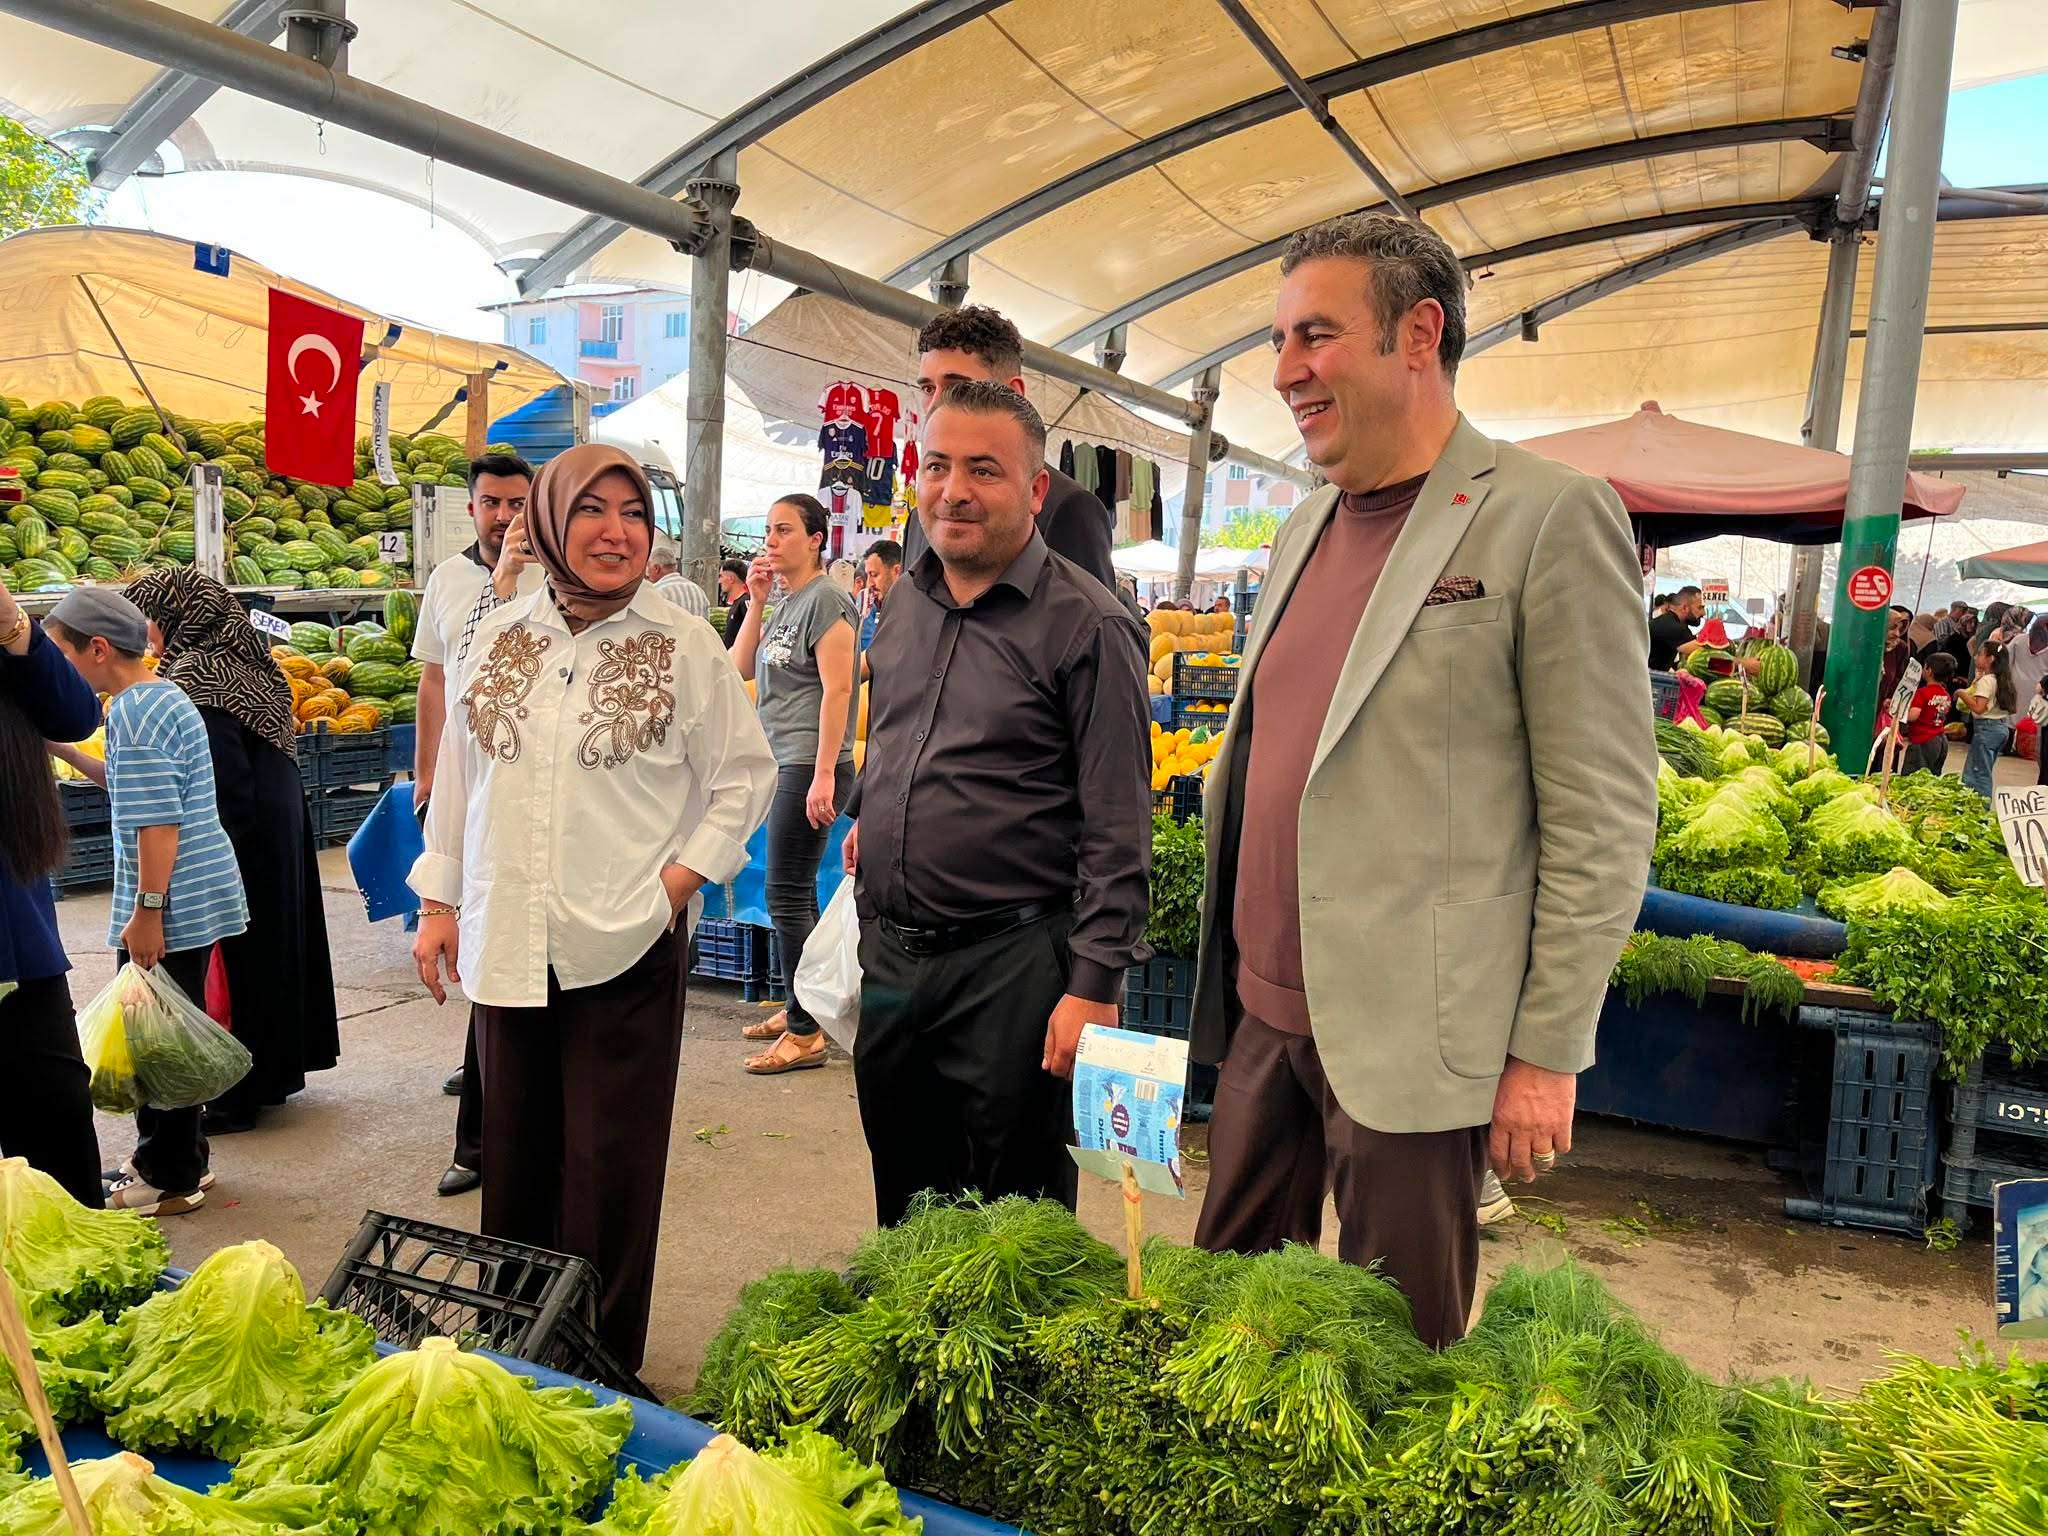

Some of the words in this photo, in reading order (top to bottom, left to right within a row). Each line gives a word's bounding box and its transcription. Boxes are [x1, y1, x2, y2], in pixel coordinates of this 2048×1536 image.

[871, 412, 883, 436] 7
[866, 457, 886, 481] 10
[379, 535, 398, 553] 12
[1998, 791, 2046, 816] TANE
